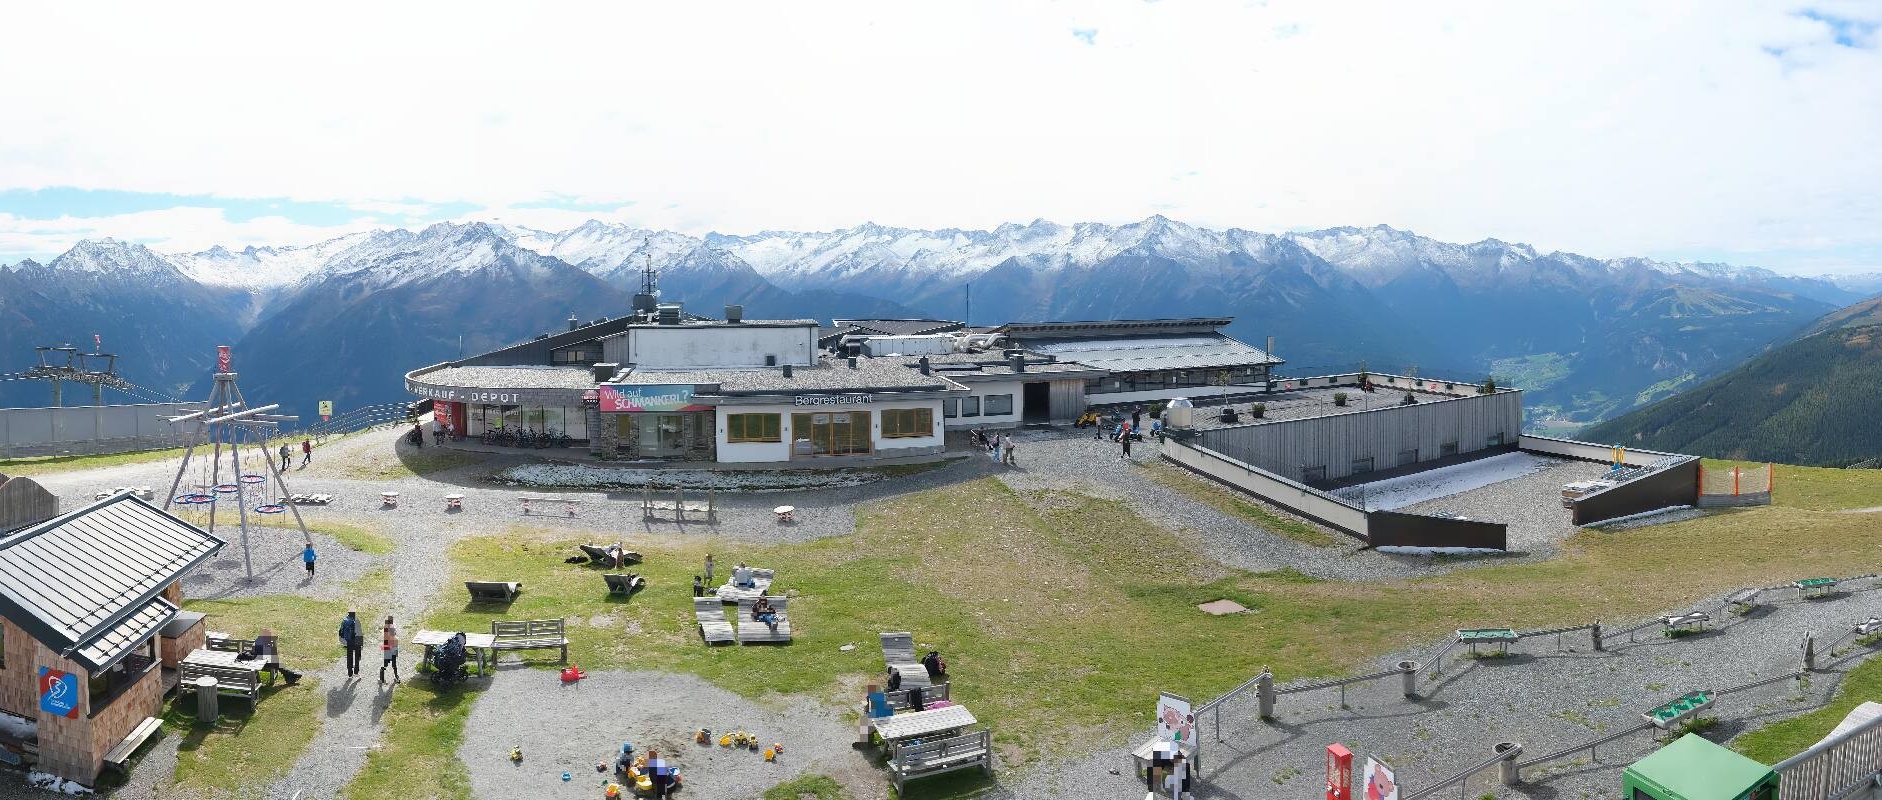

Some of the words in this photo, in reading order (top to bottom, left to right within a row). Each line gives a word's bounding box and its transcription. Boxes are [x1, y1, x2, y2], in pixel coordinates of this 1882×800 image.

[415, 386, 454, 399] VERKAUF
[471, 393, 519, 402] DEPOT
[604, 389, 625, 399] Wild
[627, 387, 642, 398] auf
[615, 390, 688, 409] SCHMANKERL?
[795, 394, 873, 406] Bergrestaurant
